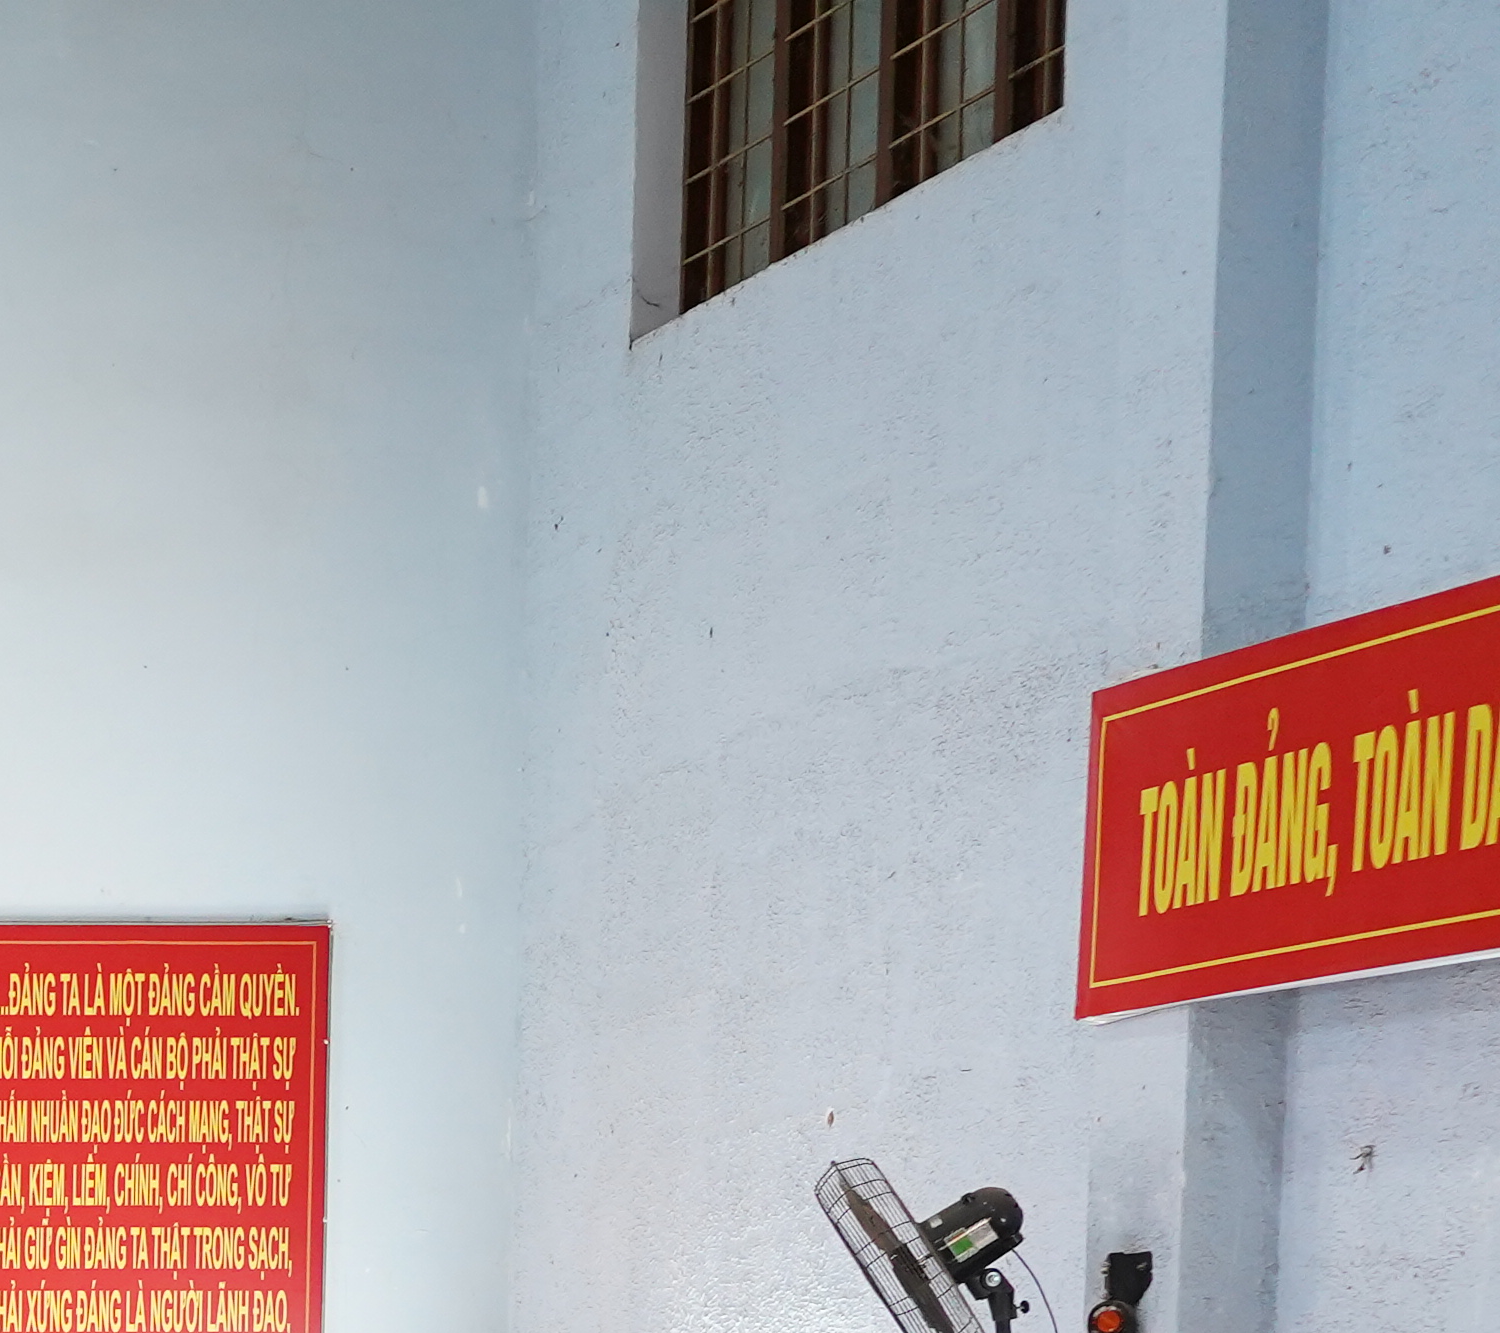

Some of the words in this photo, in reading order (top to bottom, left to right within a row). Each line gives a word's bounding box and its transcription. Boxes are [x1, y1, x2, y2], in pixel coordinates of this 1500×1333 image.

[1139, 747, 1226, 916] TOÀN
[1230, 708, 1338, 896] ĐẢNG,
[1352, 689, 1456, 872] TOÀN
[61, 974, 80, 1015] TA
[84, 963, 104, 1015] LÀ
[109, 969, 145, 1026] MỘT
[149, 963, 195, 1016] ĐẢNG
[200, 963, 235, 1016] CẦM
[240, 963, 299, 1018] QUYỀN.
[21, 1027, 65, 1079] ĐẢNG
[69, 1027, 102, 1079] VIÊN
[106, 1027, 127, 1079] VÀ
[131, 1027, 162, 1079] CÁN
[166, 1033, 188, 1090] BỘ
[191, 1027, 226, 1079] PHẢI
[231, 1033, 270, 1090] THẬT
[273, 1037, 296, 1090] SỰ
